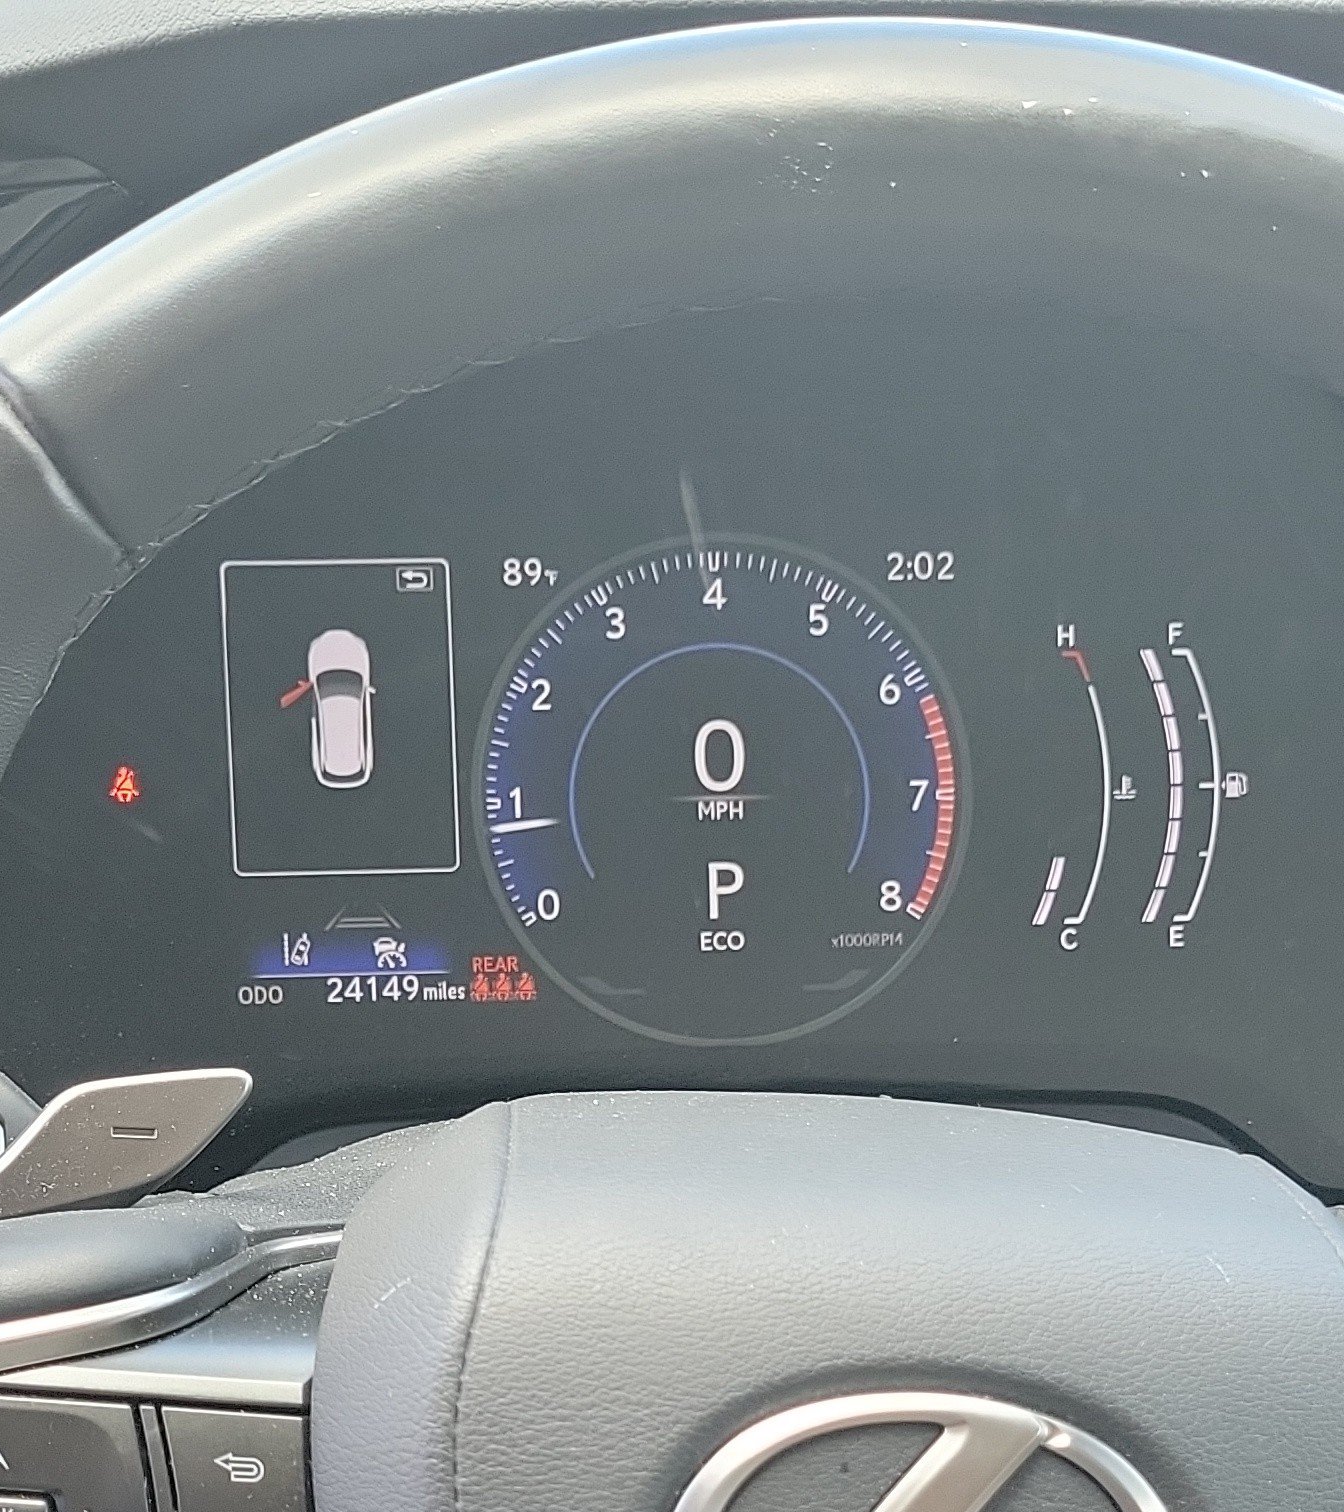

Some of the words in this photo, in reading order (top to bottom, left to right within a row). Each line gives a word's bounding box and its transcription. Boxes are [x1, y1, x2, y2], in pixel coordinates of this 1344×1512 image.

[887, 551, 955, 582] 2:02
[702, 578, 727, 610] 4
[605, 607, 626, 640] 3
[808, 604, 830, 637] 5
[1057, 624, 1076, 647] H
[1167, 622, 1184, 645] F
[531, 679, 553, 711] 2
[879, 674, 901, 705] 6
[694, 719, 745, 793] 0
[508, 787, 523, 819] 1
[697, 801, 744, 821] MPH
[909, 780, 929, 811] 7
[537, 889, 560, 921] 0
[708, 862, 744, 919] P
[879, 881, 902, 912] 8
[700, 931, 745, 952] ECO
[1060, 928, 1079, 951] C
[1169, 925, 1185, 948] E
[472, 956, 519, 973] REAR
[238, 985, 283, 1005] ODO
[326, 975, 419, 1004] 24149
[423, 982, 465, 1001] miles
